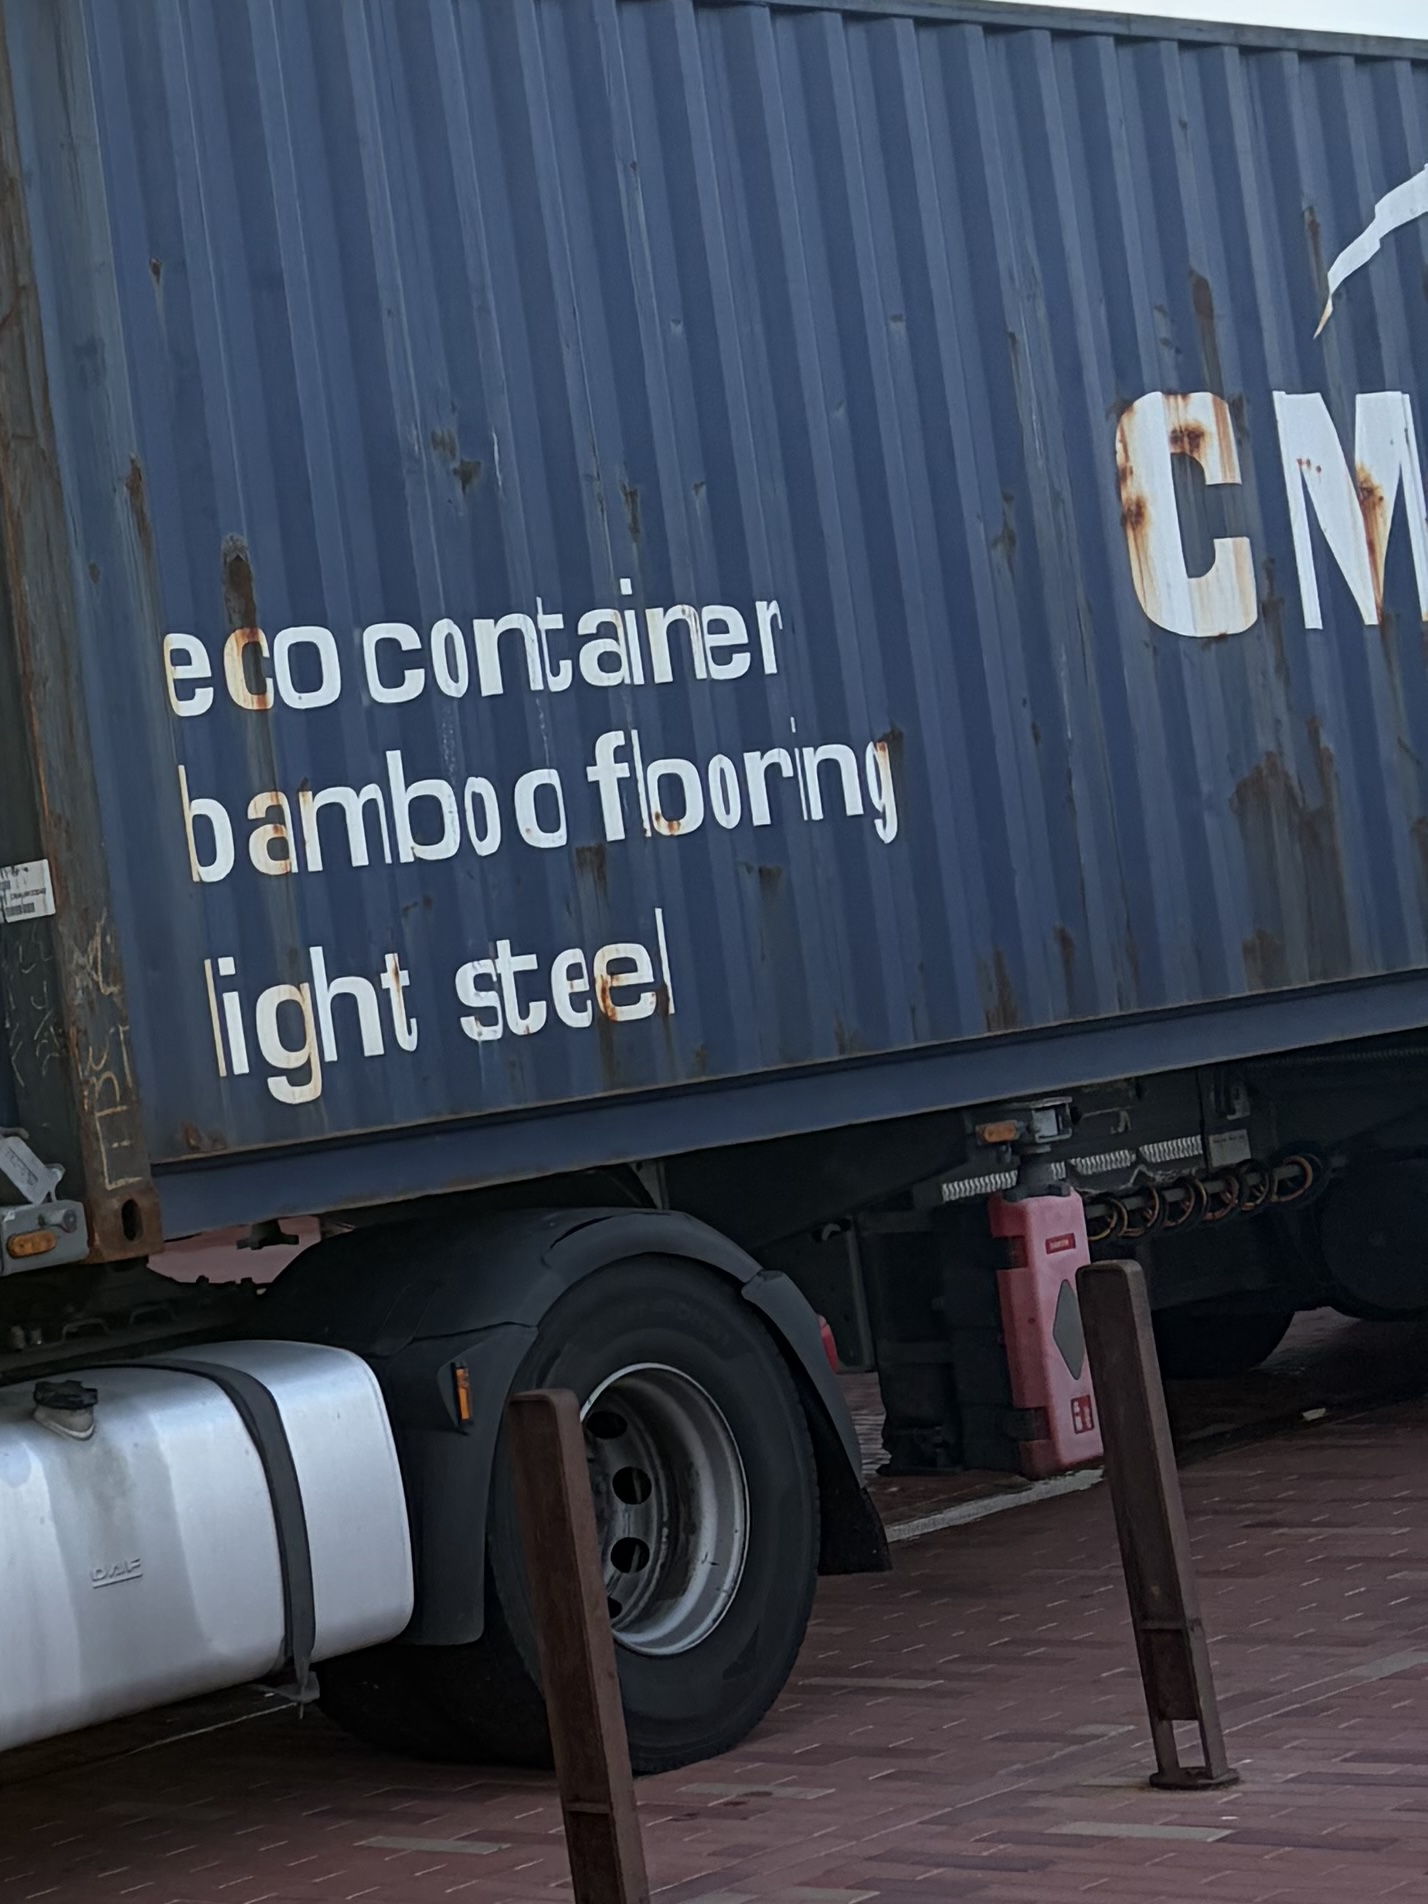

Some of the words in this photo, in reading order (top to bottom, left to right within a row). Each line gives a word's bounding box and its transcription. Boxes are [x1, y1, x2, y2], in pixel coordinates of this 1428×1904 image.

[162, 623, 344, 718] eco
[362, 578, 784, 704] container
[177, 749, 568, 884] bamboo
[586, 716, 900, 845] flooring
[204, 945, 419, 1105] light
[455, 907, 676, 1043] steel
[90, 1558, 141, 1583] DAF
